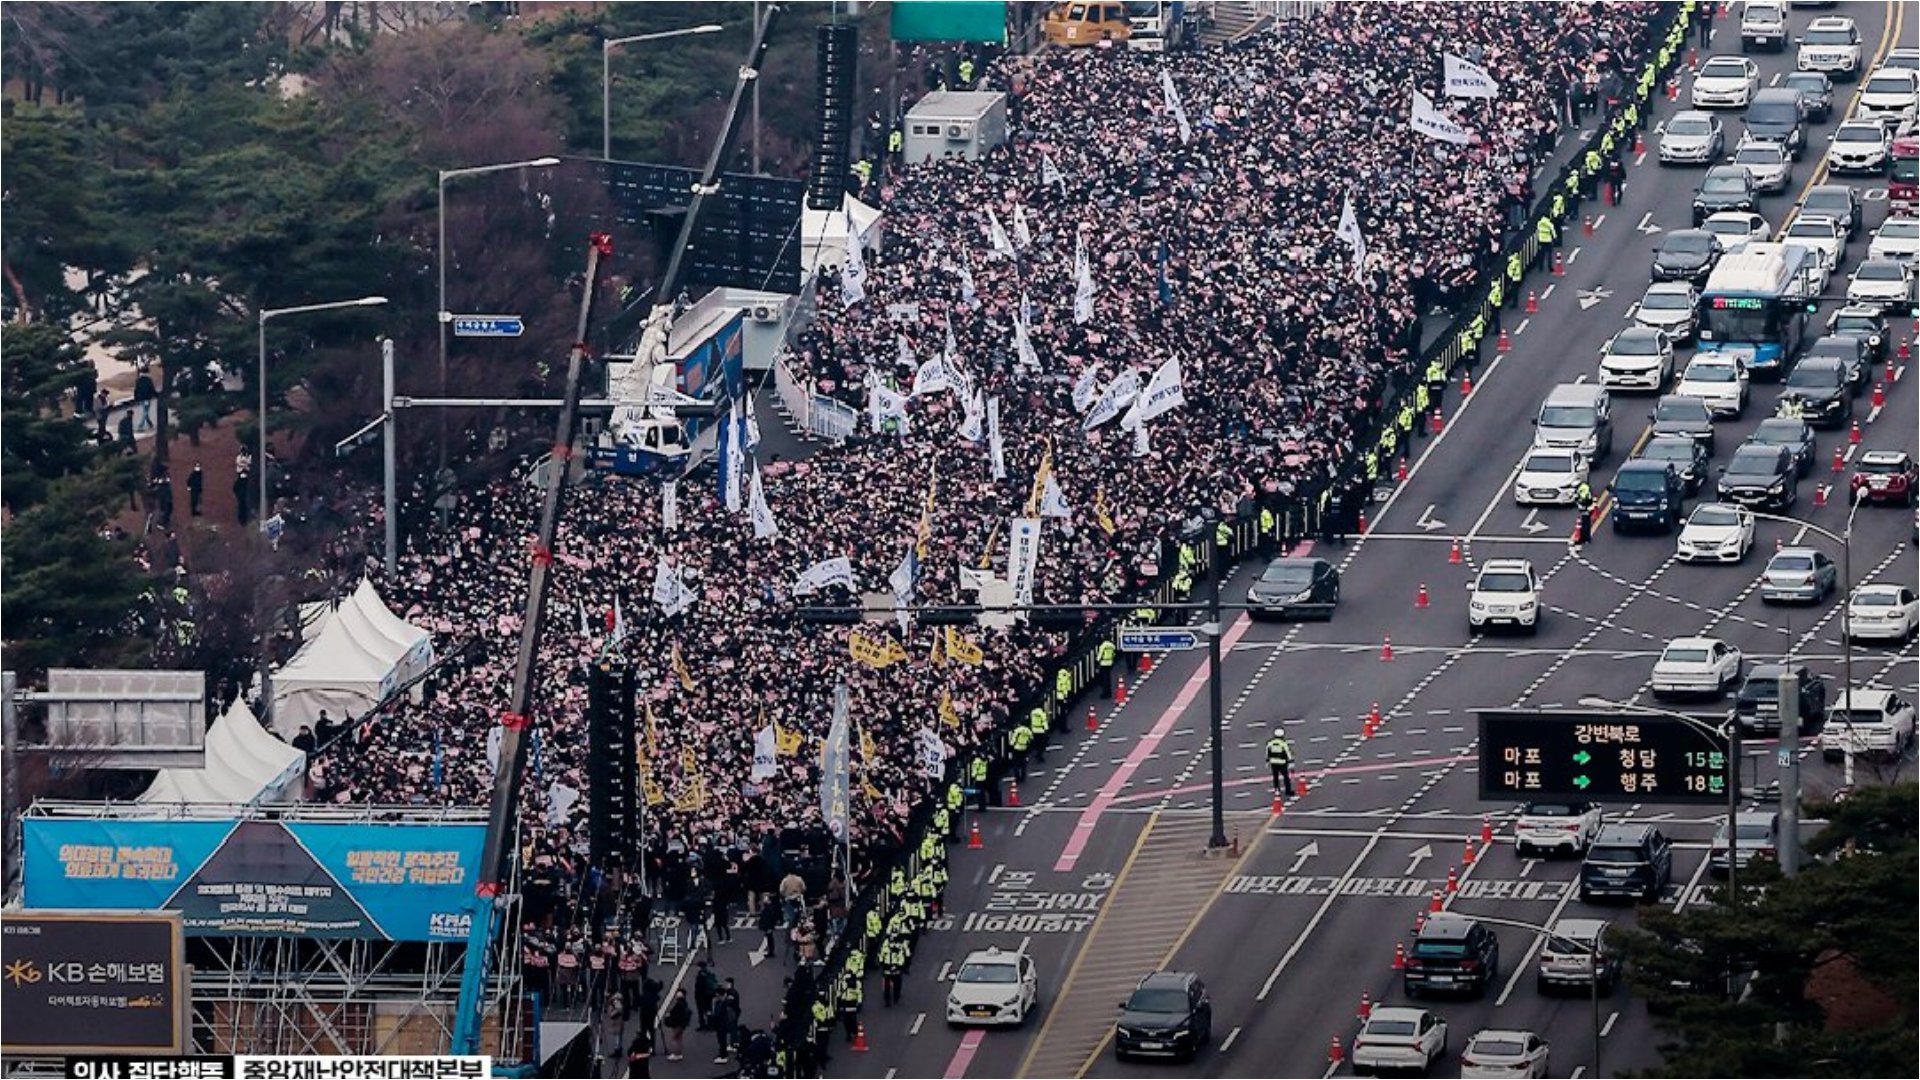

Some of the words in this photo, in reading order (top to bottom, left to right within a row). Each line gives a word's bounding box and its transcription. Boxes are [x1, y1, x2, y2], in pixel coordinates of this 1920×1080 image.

[1574, 724, 1641, 744] 강변북로
[1504, 747, 1542, 765] 마포
[1619, 749, 1657, 768] 청담
[1684, 751, 1725, 769] 15분
[1504, 771, 1542, 789] 마포
[1620, 773, 1658, 792] 행주
[1684, 775, 1725, 794] 18분
[1224, 876, 1341, 895] 마포대교
[1340, 878, 1451, 897] 마포대교
[1457, 880, 1571, 899] 마포대교
[986, 892, 1106, 910] 지하도로
